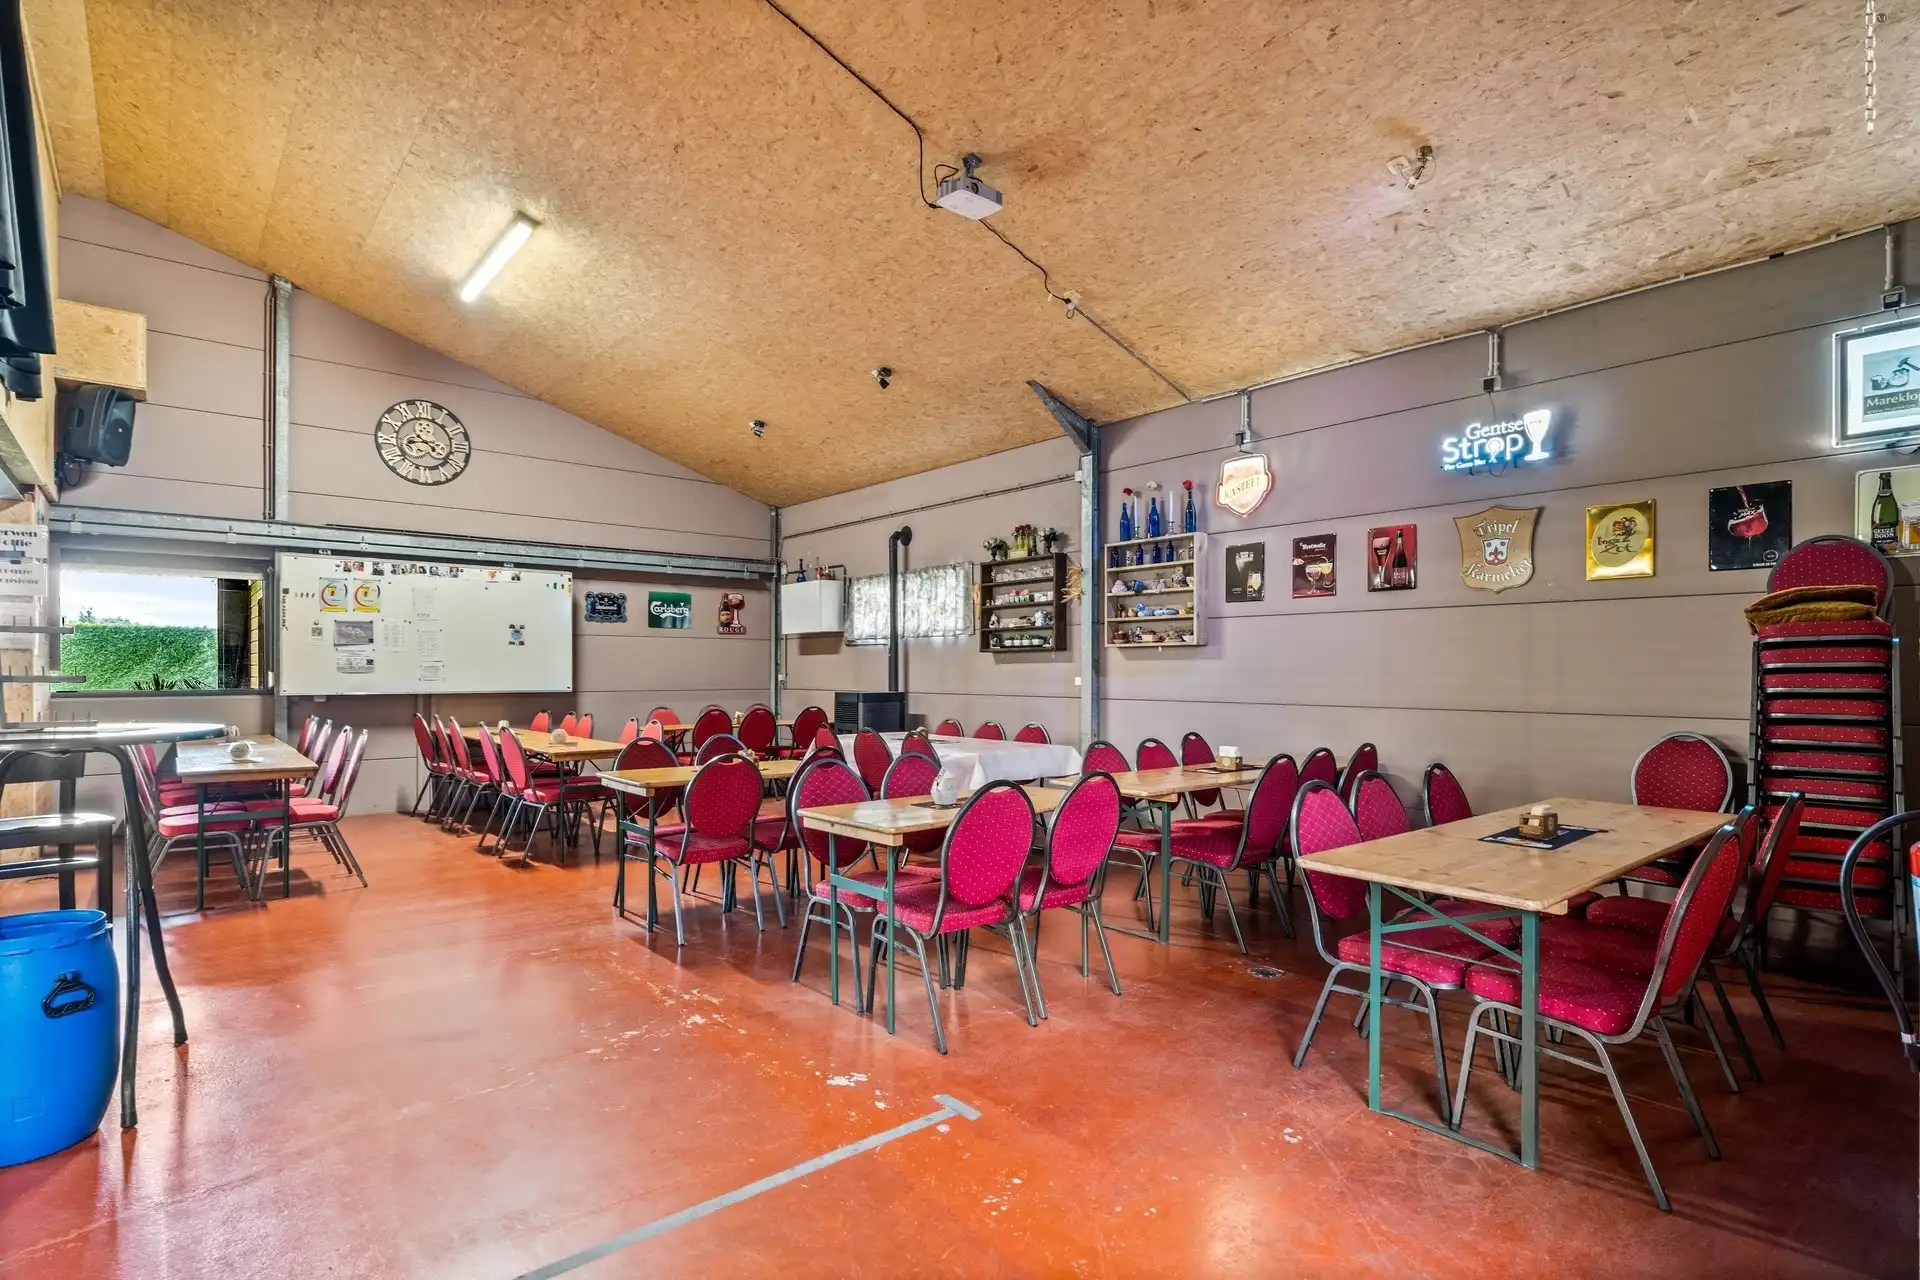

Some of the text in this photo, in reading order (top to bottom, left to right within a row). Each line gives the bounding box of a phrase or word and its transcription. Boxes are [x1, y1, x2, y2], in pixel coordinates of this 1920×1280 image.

[415, 401, 433, 419] XII
[1465, 420, 1524, 440] Gentse
[1442, 434, 1524, 463] Strop
[1473, 519, 1521, 537] Tripel
[650, 601, 690, 618] Carlsberg
